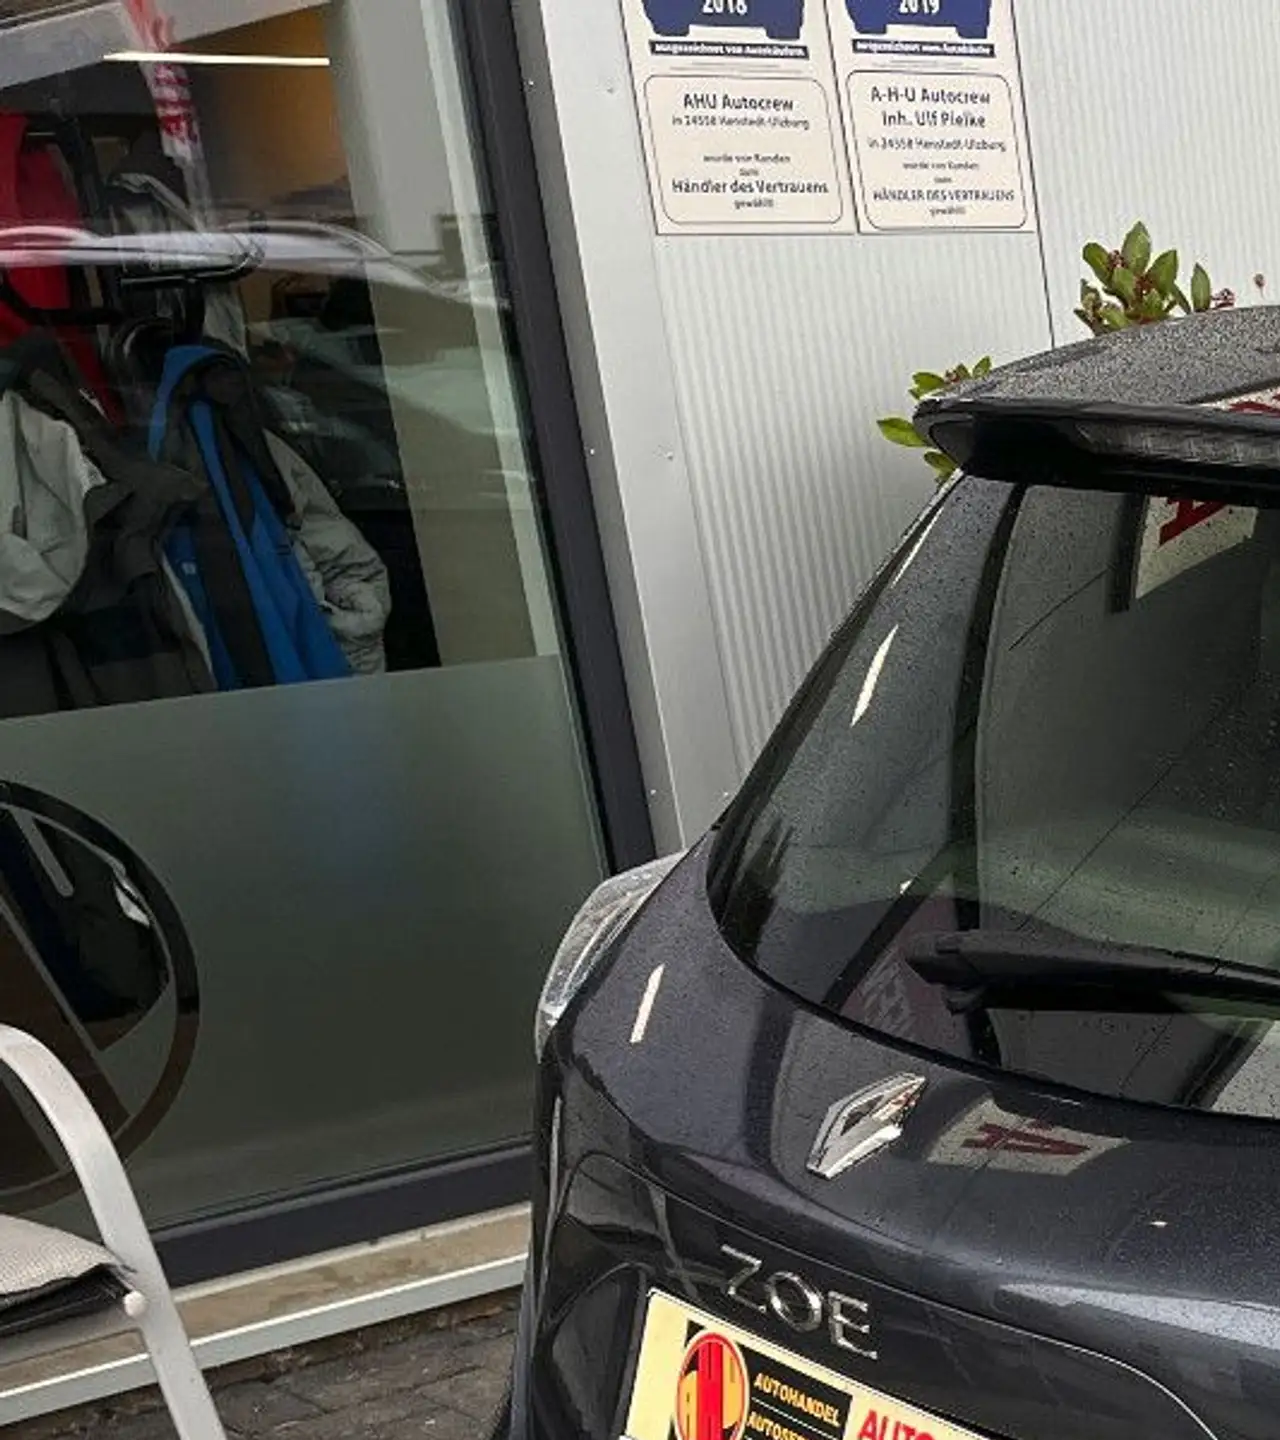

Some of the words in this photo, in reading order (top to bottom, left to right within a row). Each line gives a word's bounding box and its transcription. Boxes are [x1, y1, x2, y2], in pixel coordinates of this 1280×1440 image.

[684, 94, 716, 110] AHU
[722, 94, 793, 111] Autocrew
[871, 86, 916, 104] A-H-U
[921, 86, 991, 105] Autocrew
[730, 178, 754, 194] des
[756, 178, 829, 194] Vertrauens
[720, 1244, 879, 1361] ZOE
[754, 1372, 841, 1428] AUTOHANDEL
